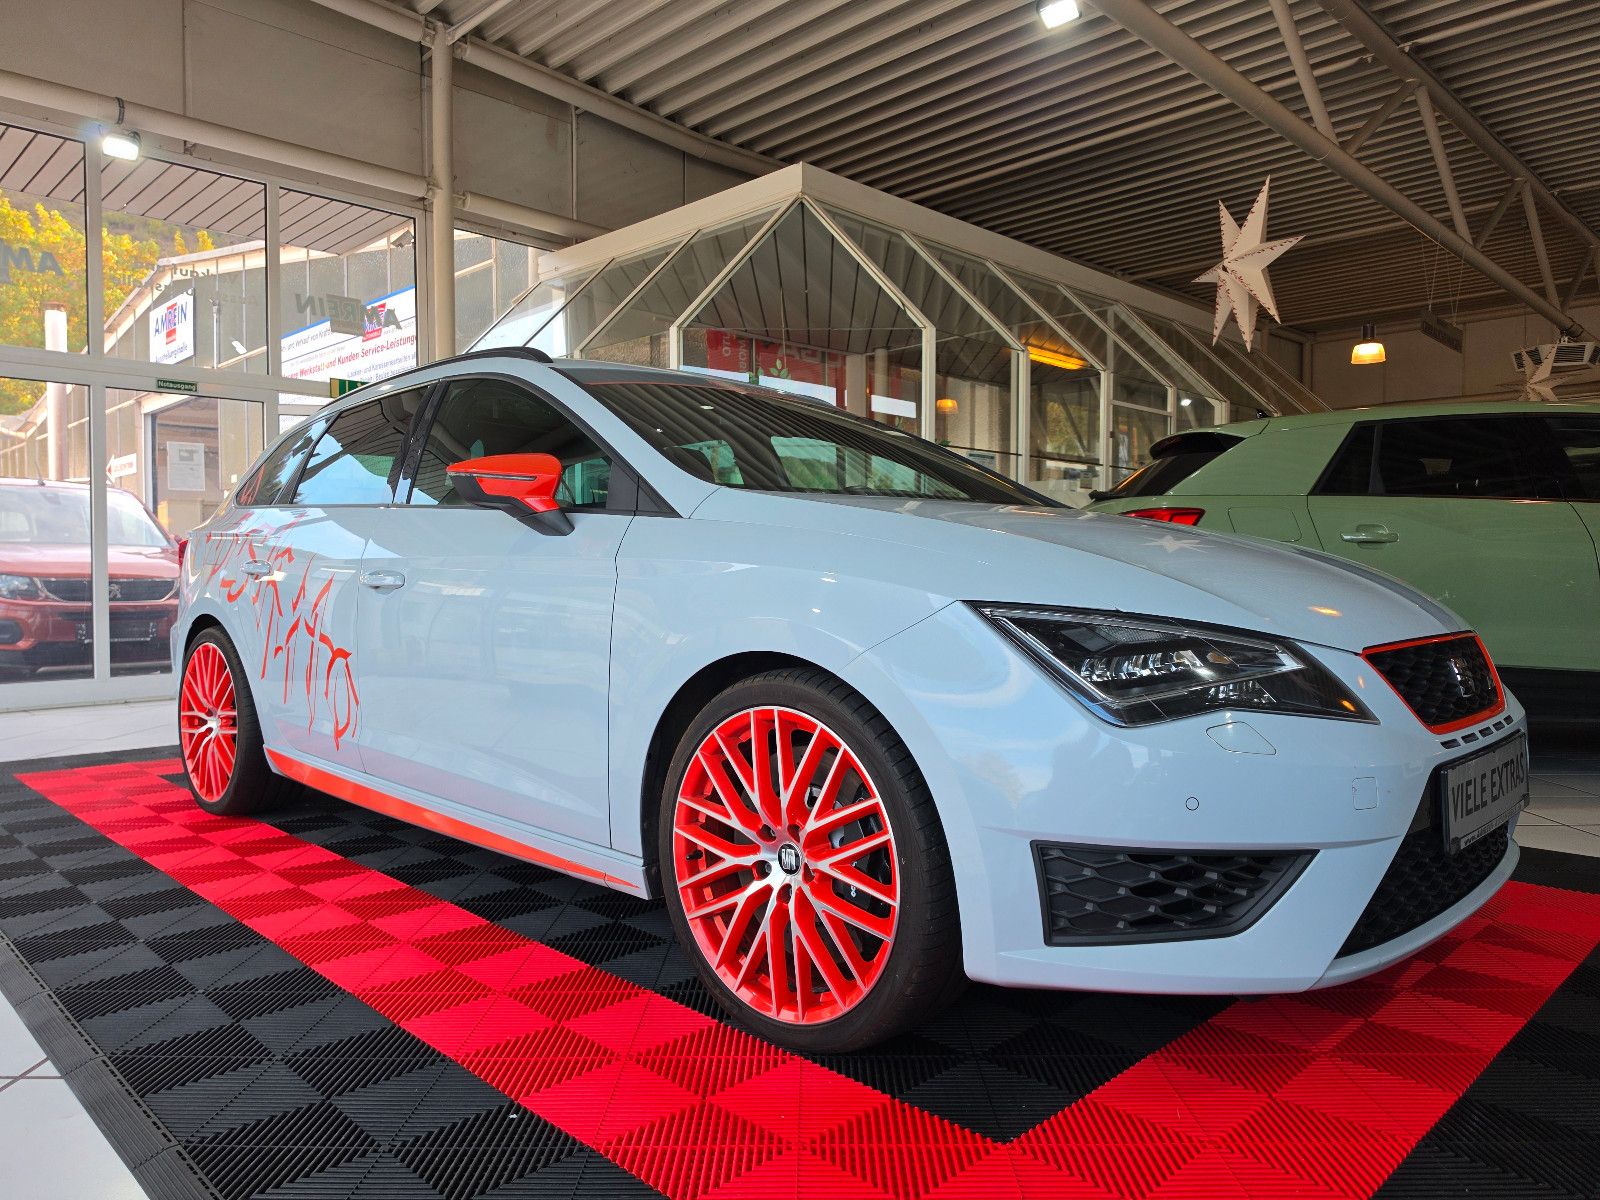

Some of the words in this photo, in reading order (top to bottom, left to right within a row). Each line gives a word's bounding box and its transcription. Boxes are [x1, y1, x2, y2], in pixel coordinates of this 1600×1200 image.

[154, 301, 187, 337] AMREIN
[361, 334, 416, 358] Service-Leistung
[158, 381, 197, 390] Notausgang
[1452, 773, 1488, 823] VIELE
[1490, 752, 1525, 803] EXTRAS
